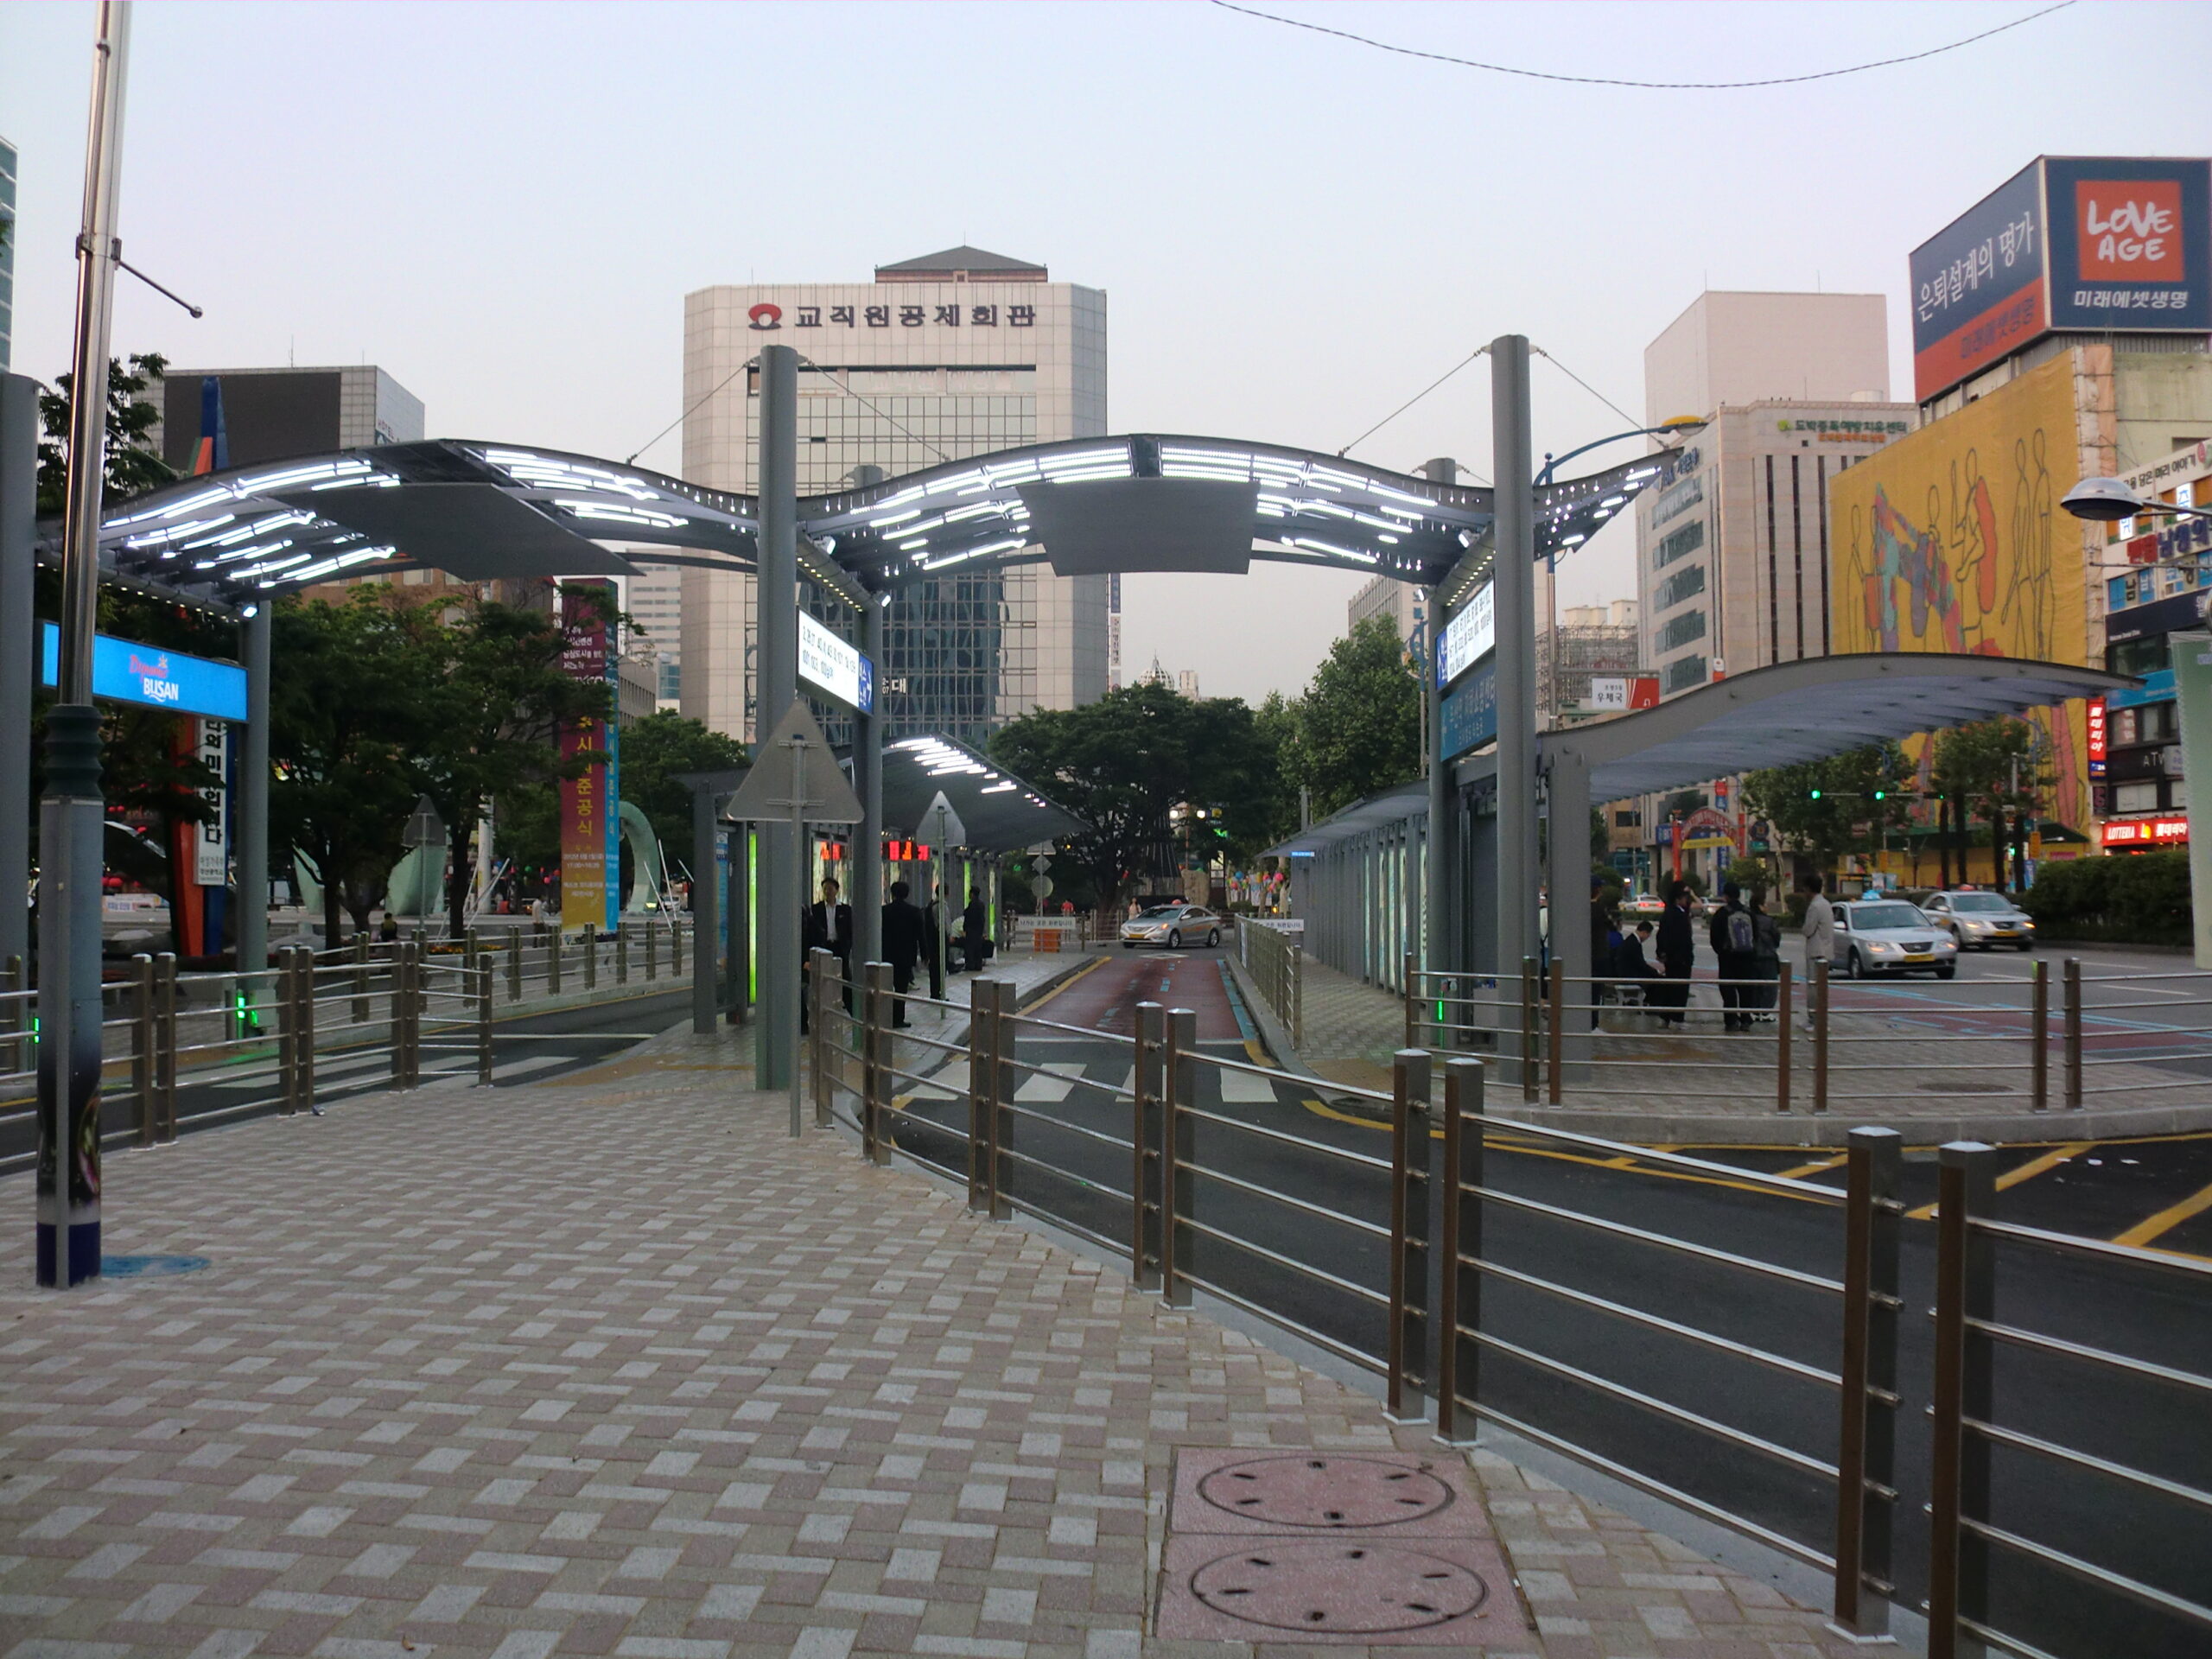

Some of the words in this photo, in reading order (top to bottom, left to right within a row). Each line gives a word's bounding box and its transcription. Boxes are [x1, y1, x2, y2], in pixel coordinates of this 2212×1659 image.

[2087, 200, 2174, 238] LOVE
[2098, 234, 2166, 263] AGE
[1917, 238, 1993, 322] 은퇴설계의
[1999, 210, 2034, 267] 명가
[2074, 290, 2188, 309] 미래에셋생명
[795, 304, 1036, 328] 교직원공제회관
[2171, 454, 2196, 473] 이야기
[143, 677, 179, 701] BUSAN
[1598, 692, 1623, 702] 우체국
[2090, 707, 2103, 752] 롯데리아
[2107, 826, 2135, 840] LOTTERIA
[2156, 823, 2188, 836] 롯데리아
